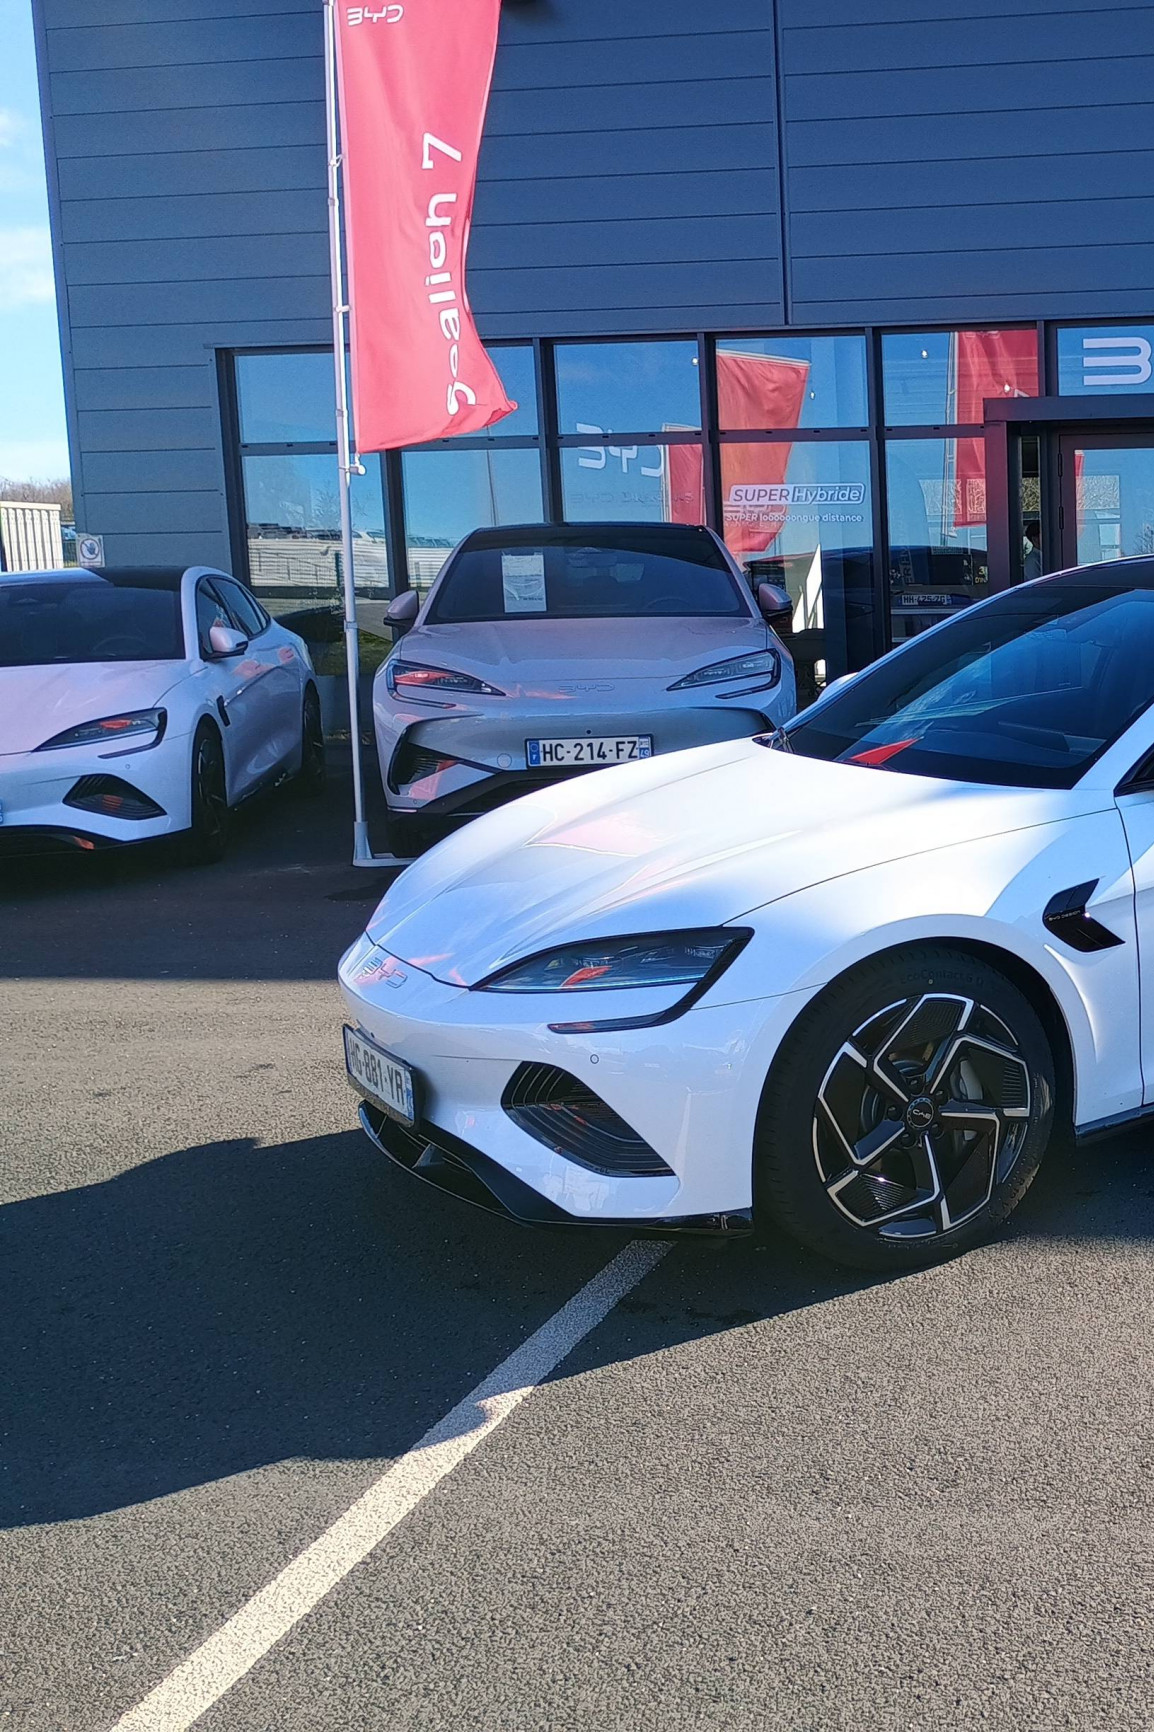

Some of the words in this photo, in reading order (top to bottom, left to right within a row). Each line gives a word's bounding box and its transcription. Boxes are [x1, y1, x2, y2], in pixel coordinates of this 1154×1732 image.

[347, 4, 404, 26] BYD
[421, 132, 461, 169] 7
[733, 488, 790, 502] SUPER
[794, 486, 861, 504] Hybride
[726, 512, 757, 522] SUPER
[821, 512, 863, 522] distance
[542, 740, 638, 762] HC-214-FZ
